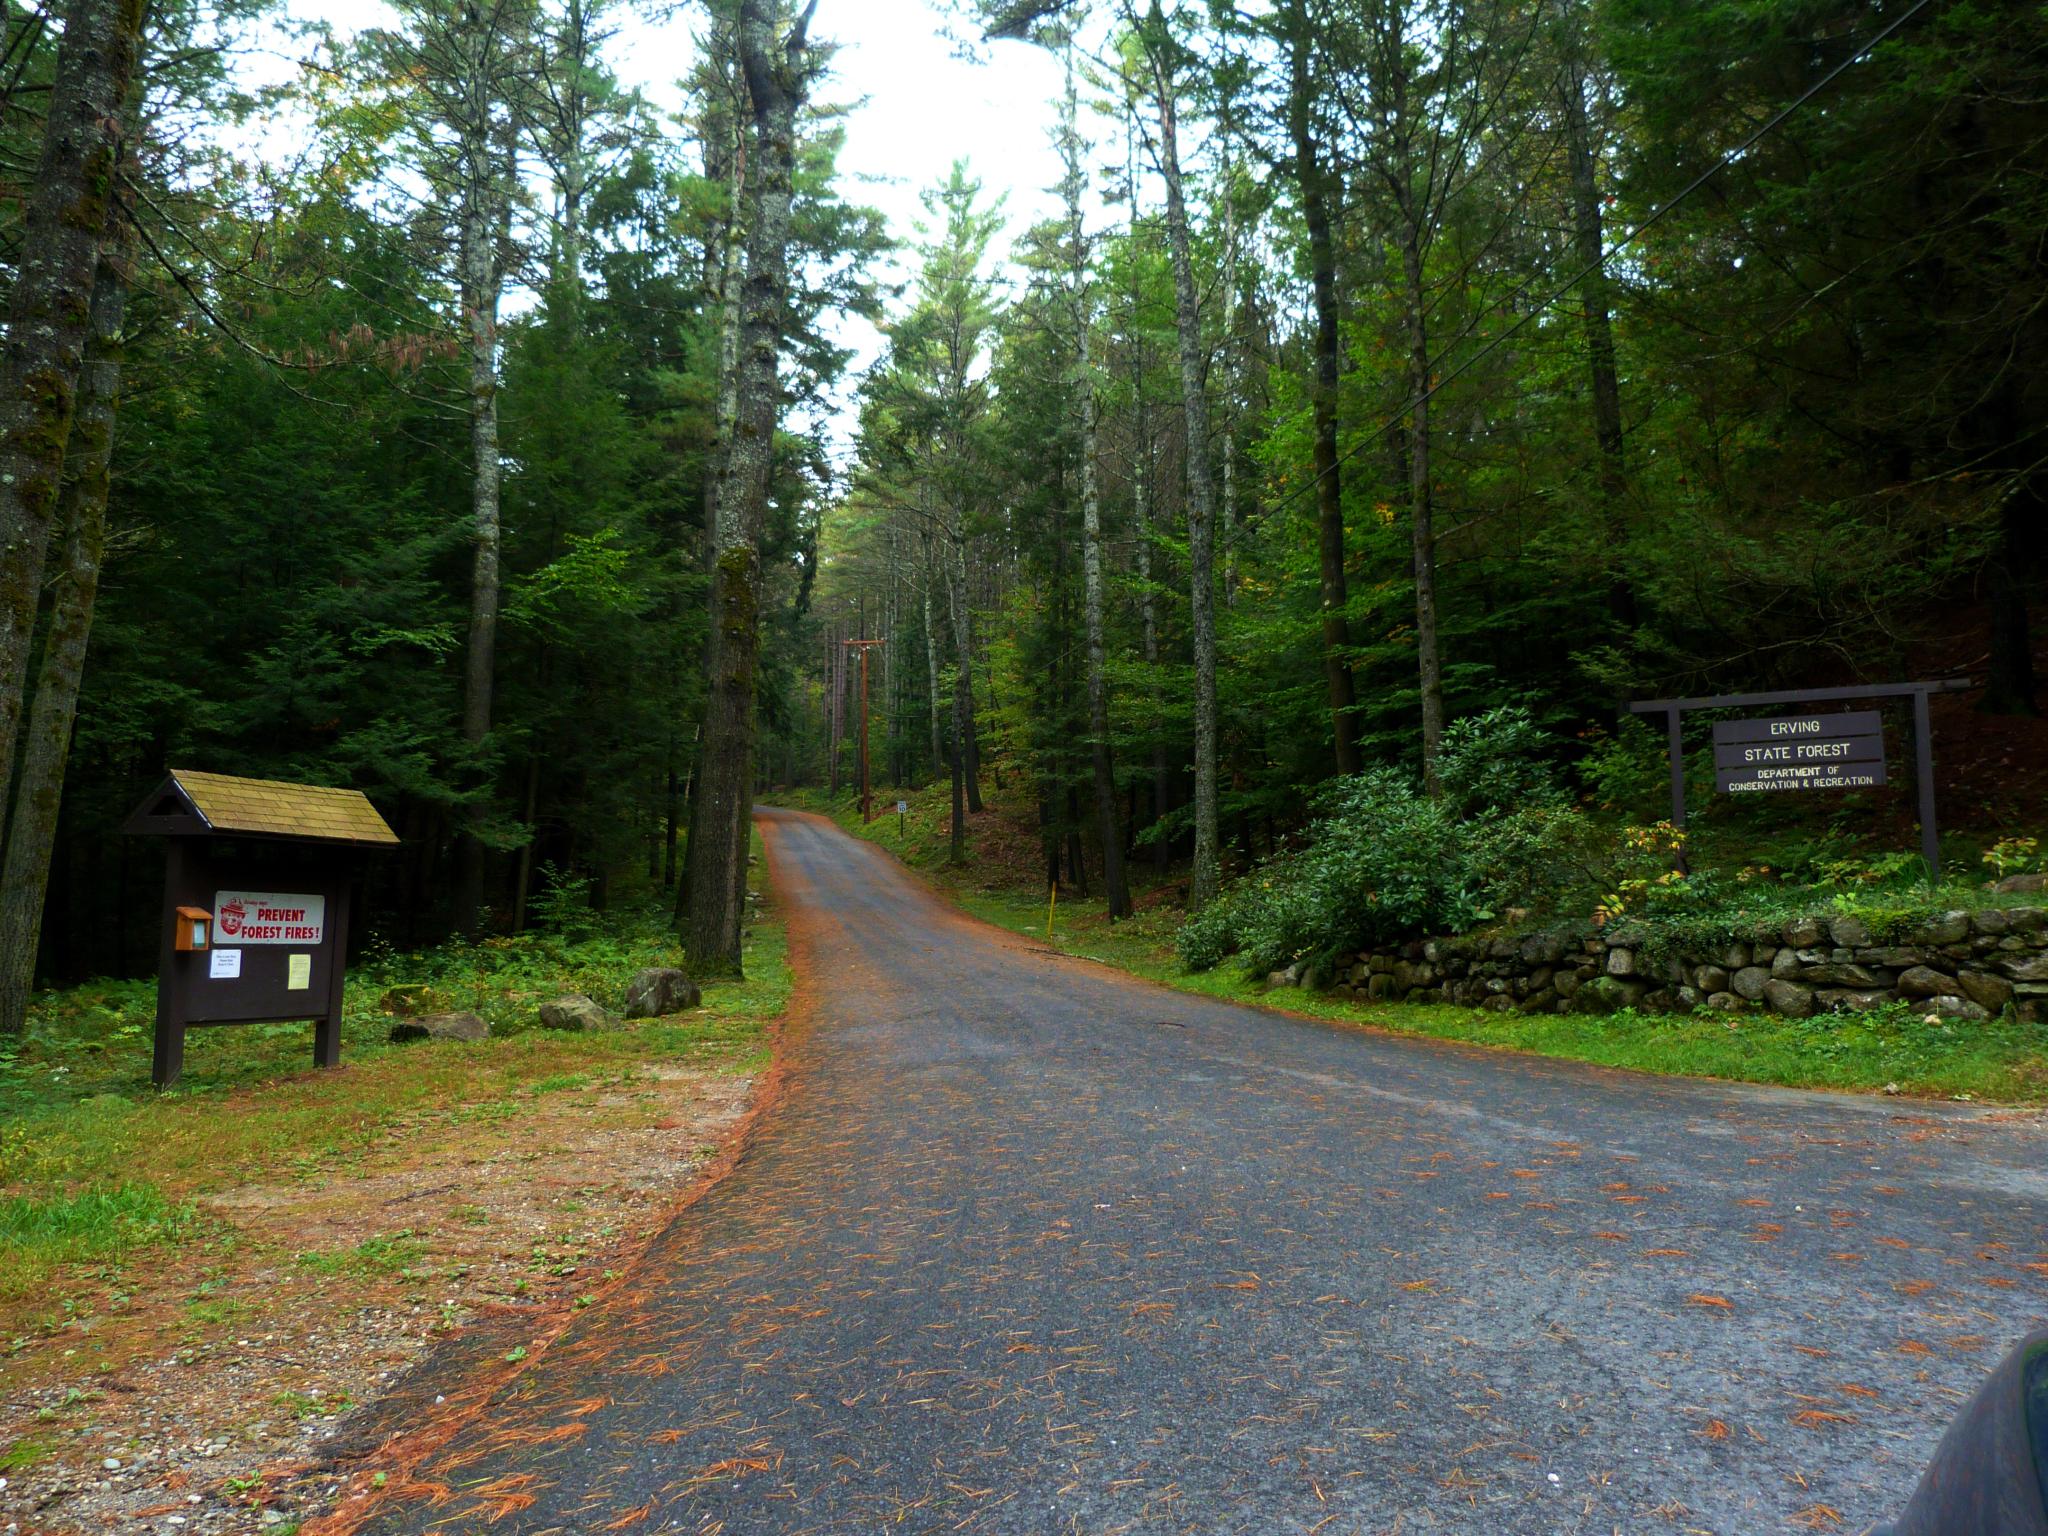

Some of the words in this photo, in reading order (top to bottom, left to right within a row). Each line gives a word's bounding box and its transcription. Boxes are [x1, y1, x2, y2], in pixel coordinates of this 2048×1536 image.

[1771, 721, 1820, 735] ERVING
[1745, 747, 1791, 761] STATE
[1797, 743, 1850, 758] FOREST
[1758, 766, 1820, 779] DEPARTMENT
[1828, 766, 1840, 775] OF
[1728, 780, 1799, 792] CONSERVATION
[1803, 780, 1809, 788] &
[1814, 776, 1873, 787] RECREATION
[258, 908, 305, 921] PREVENT
[241, 926, 282, 939] FOREST
